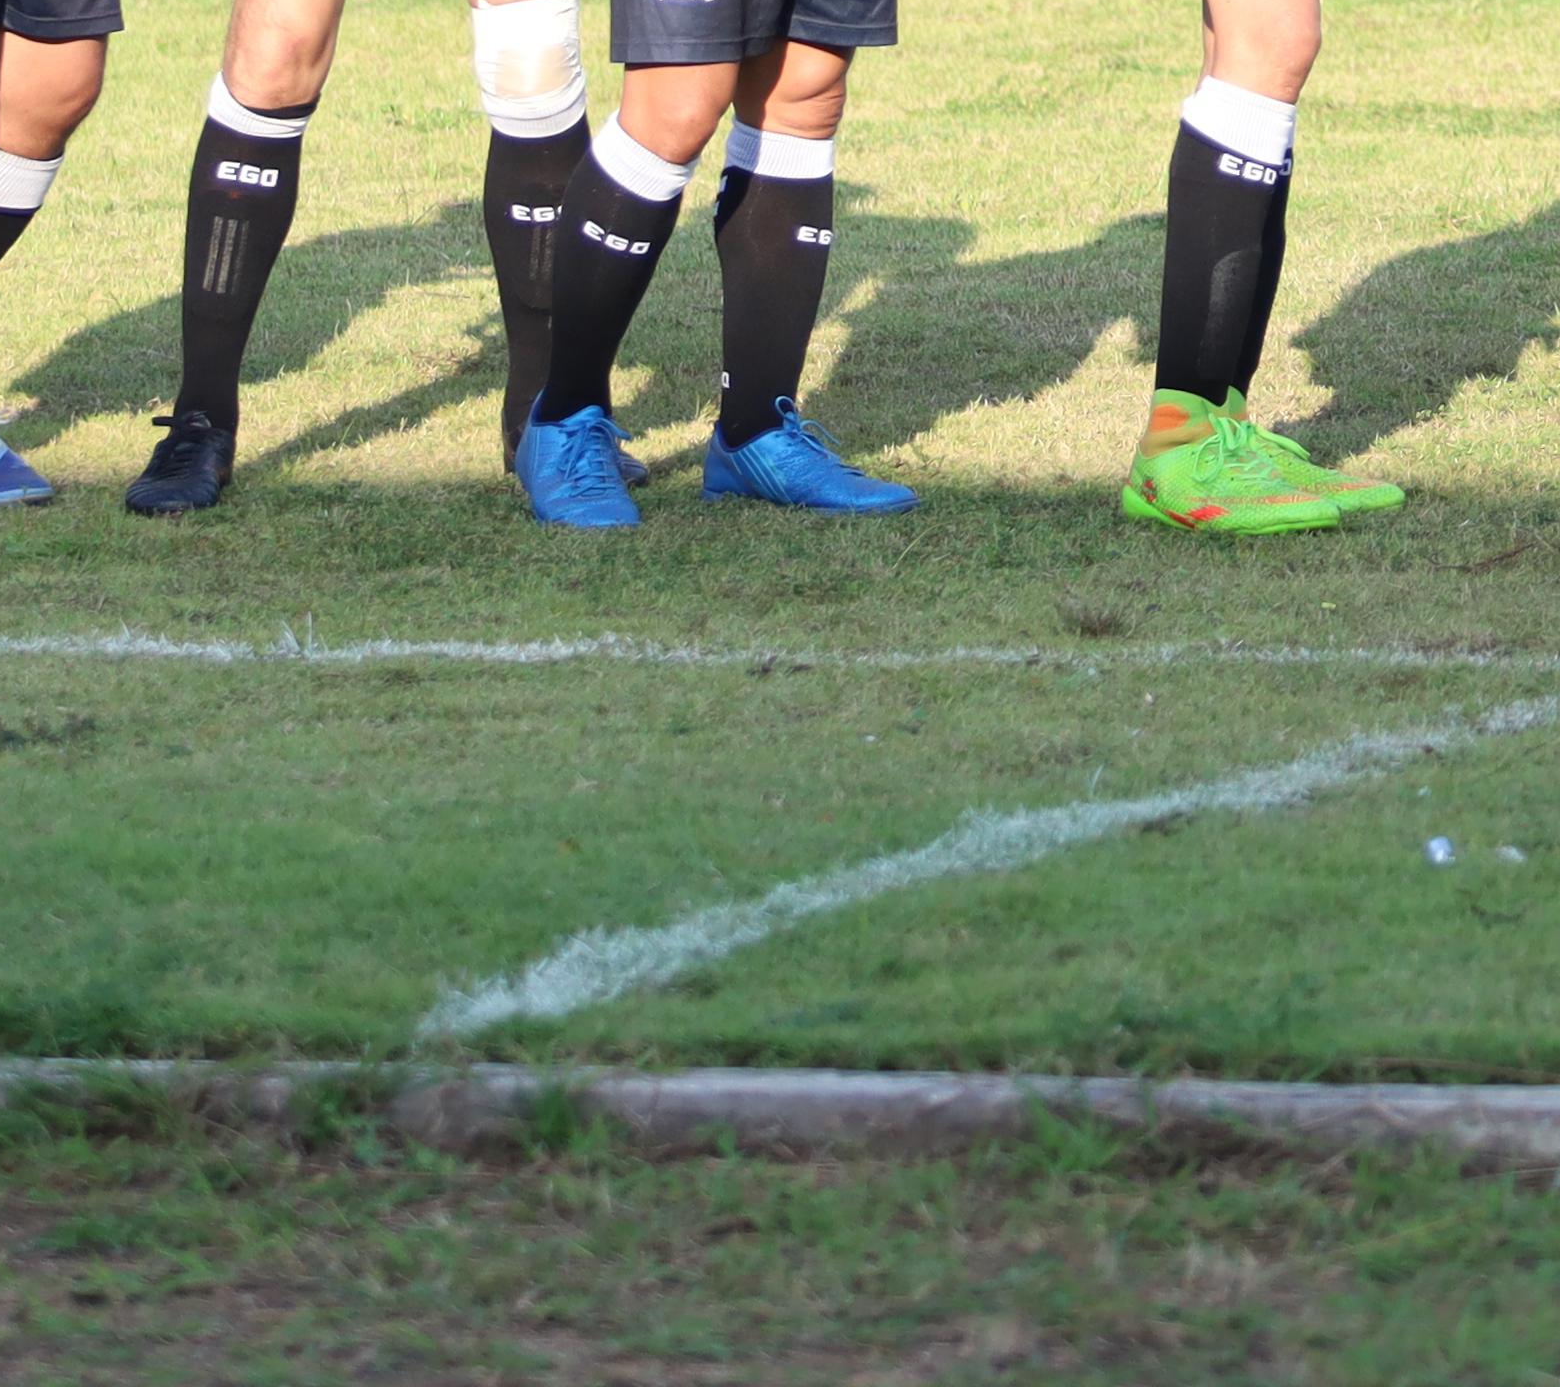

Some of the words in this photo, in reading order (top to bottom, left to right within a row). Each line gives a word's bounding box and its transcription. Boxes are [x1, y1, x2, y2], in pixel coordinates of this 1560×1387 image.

[216, 160, 280, 188] EGO
[1217, 152, 1278, 186] EGO
[511, 203, 562, 223] EG
[582, 220, 652, 256] EGO
[796, 225, 834, 246] EG
